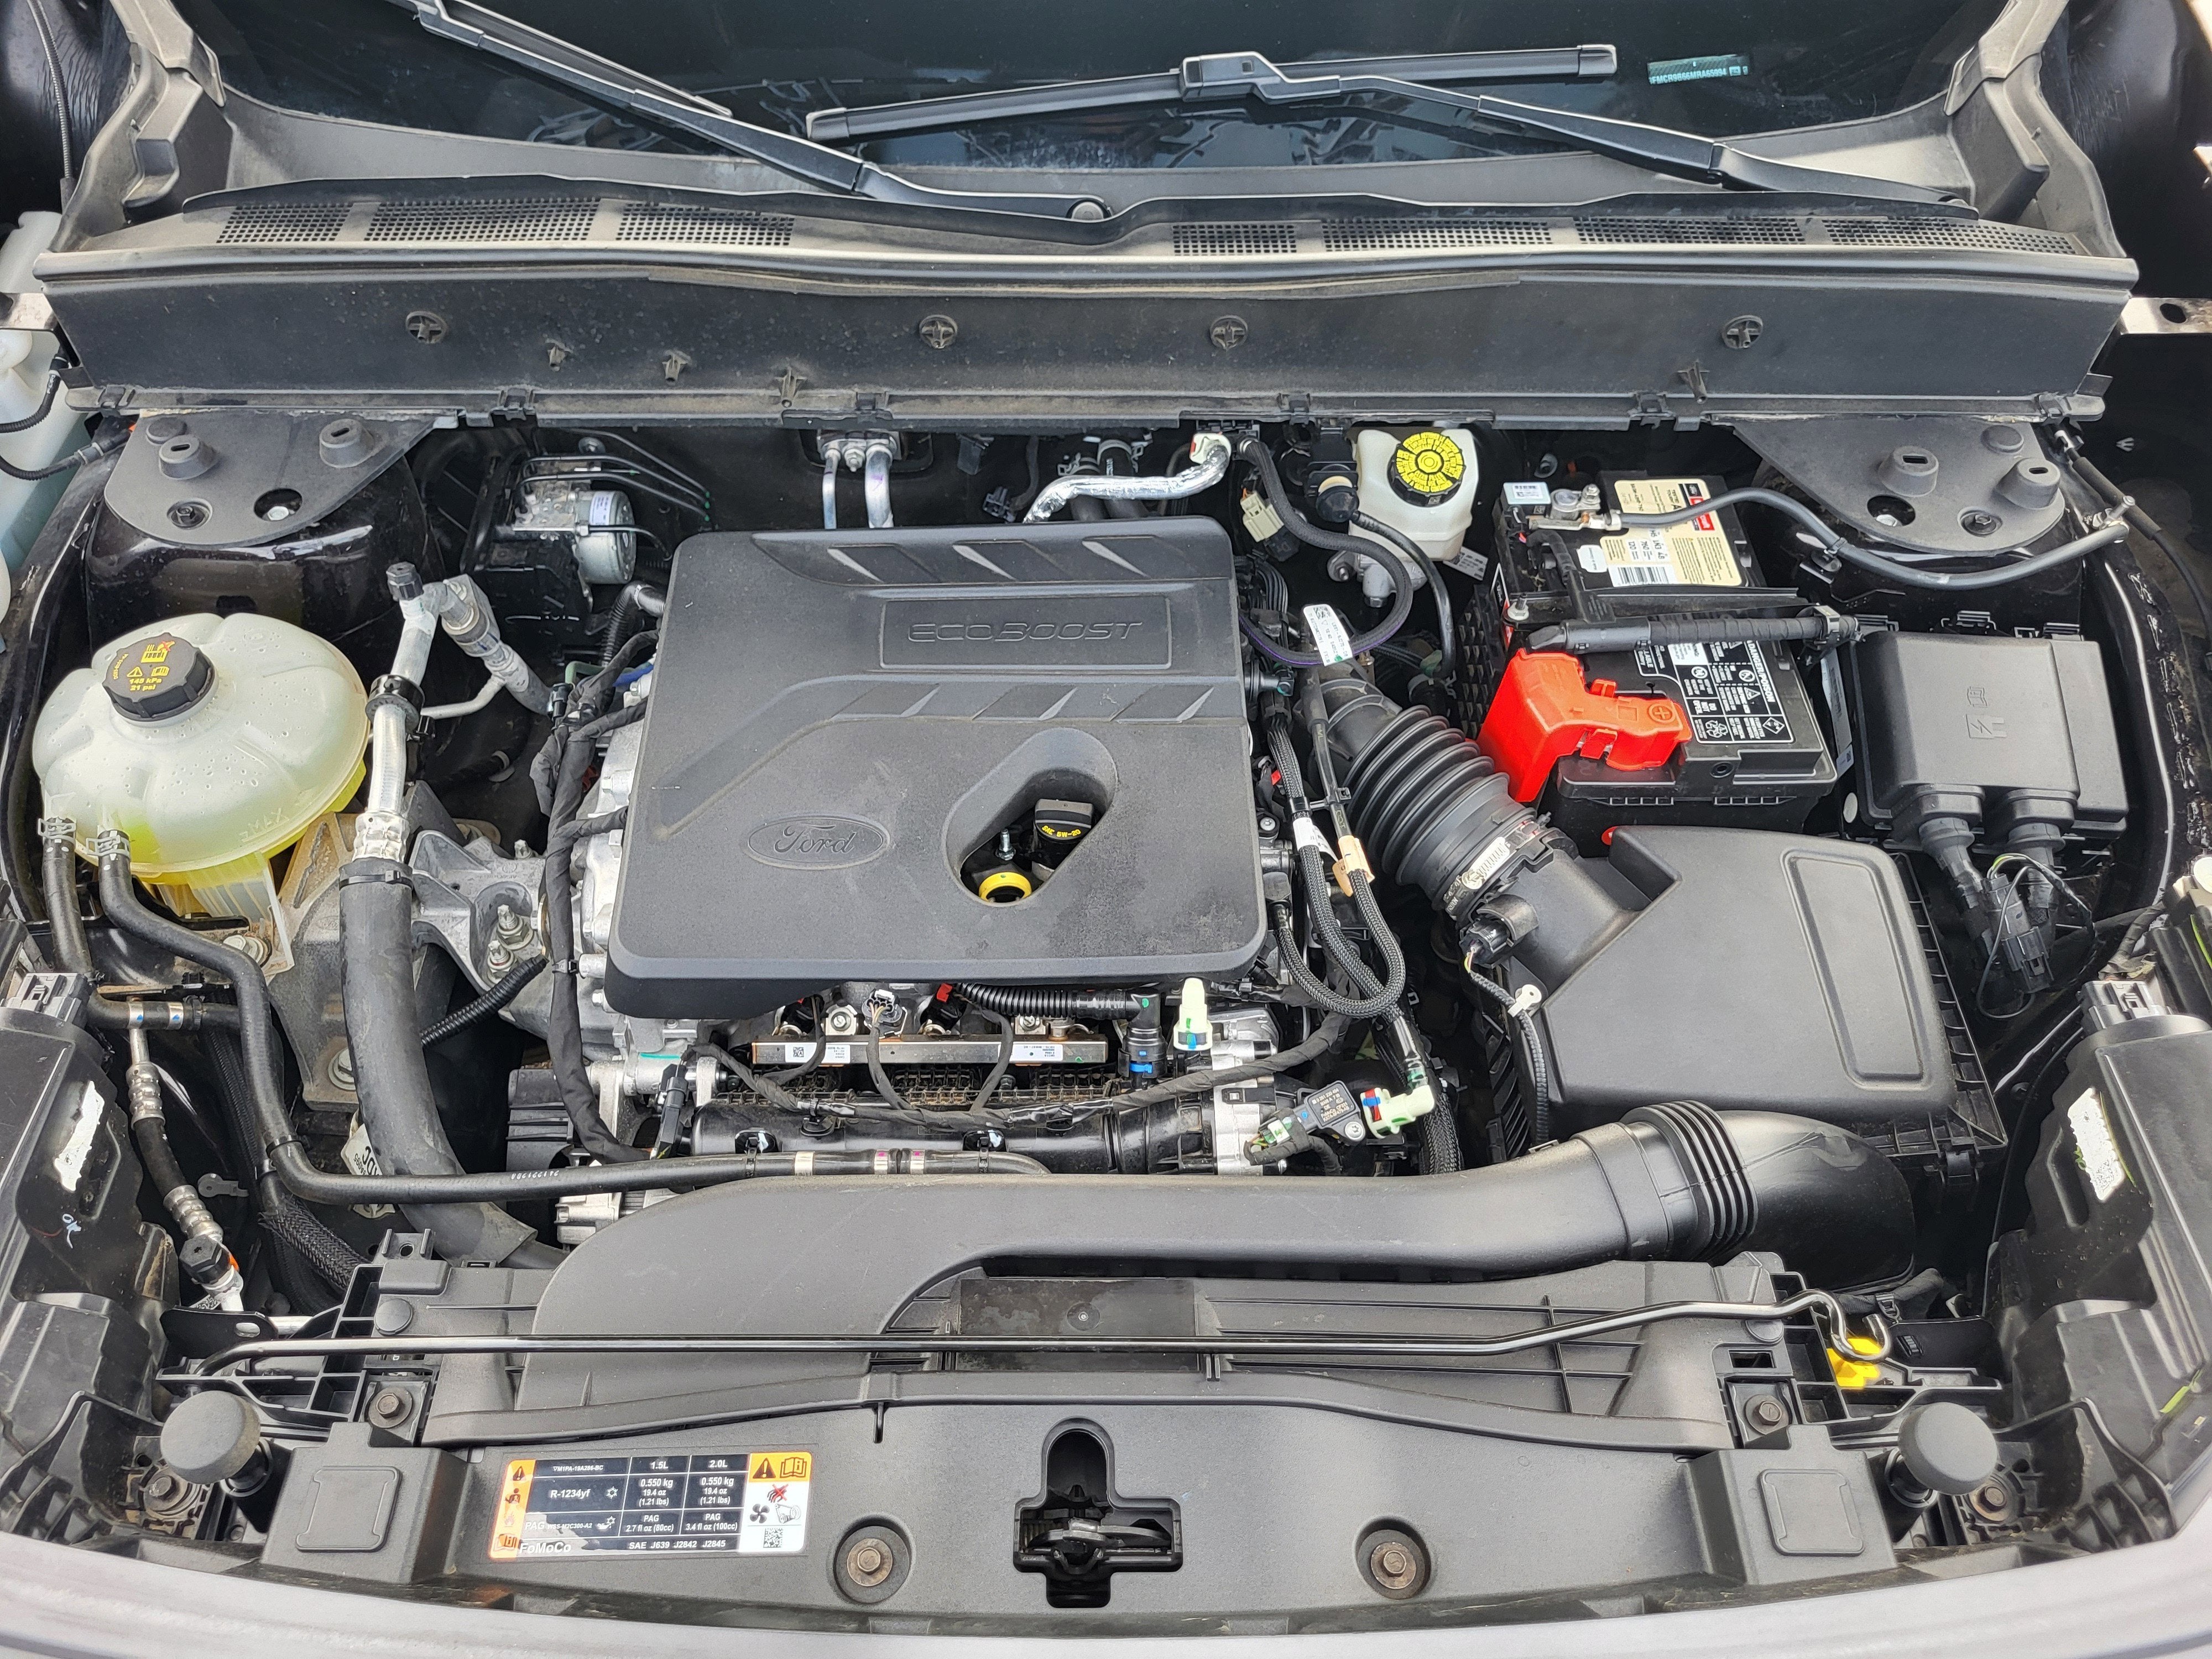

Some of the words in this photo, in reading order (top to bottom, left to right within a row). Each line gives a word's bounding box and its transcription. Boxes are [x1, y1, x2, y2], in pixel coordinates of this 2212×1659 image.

[907, 622, 1143, 643] ECOBOOST
[1746, 644, 1776, 702] DANGER/POISON
[1041, 825, 1055, 836] SAE
[774, 823, 857, 854] Ford
[640, 1479, 661, 1487] 0.550
[663, 1478, 674, 1488] kg
[701, 1477, 722, 1485] 0.550
[724, 1477, 734, 1486] kg
[550, 1489, 591, 1499] R-1234yf
[639, 1498, 655, 1507] (1.21
[656, 1497, 669, 1506] lbs)
[700, 1497, 716, 1505] (1.21
[717, 1496, 731, 1505] lbs)
[525, 1522, 545, 1530] PAG
[653, 1524, 674, 1533] (80cc)
[713, 1522, 738, 1531] (100cc)
[519, 1541, 571, 1554] FoMoCo
[702, 1540, 726, 1548] J2845
